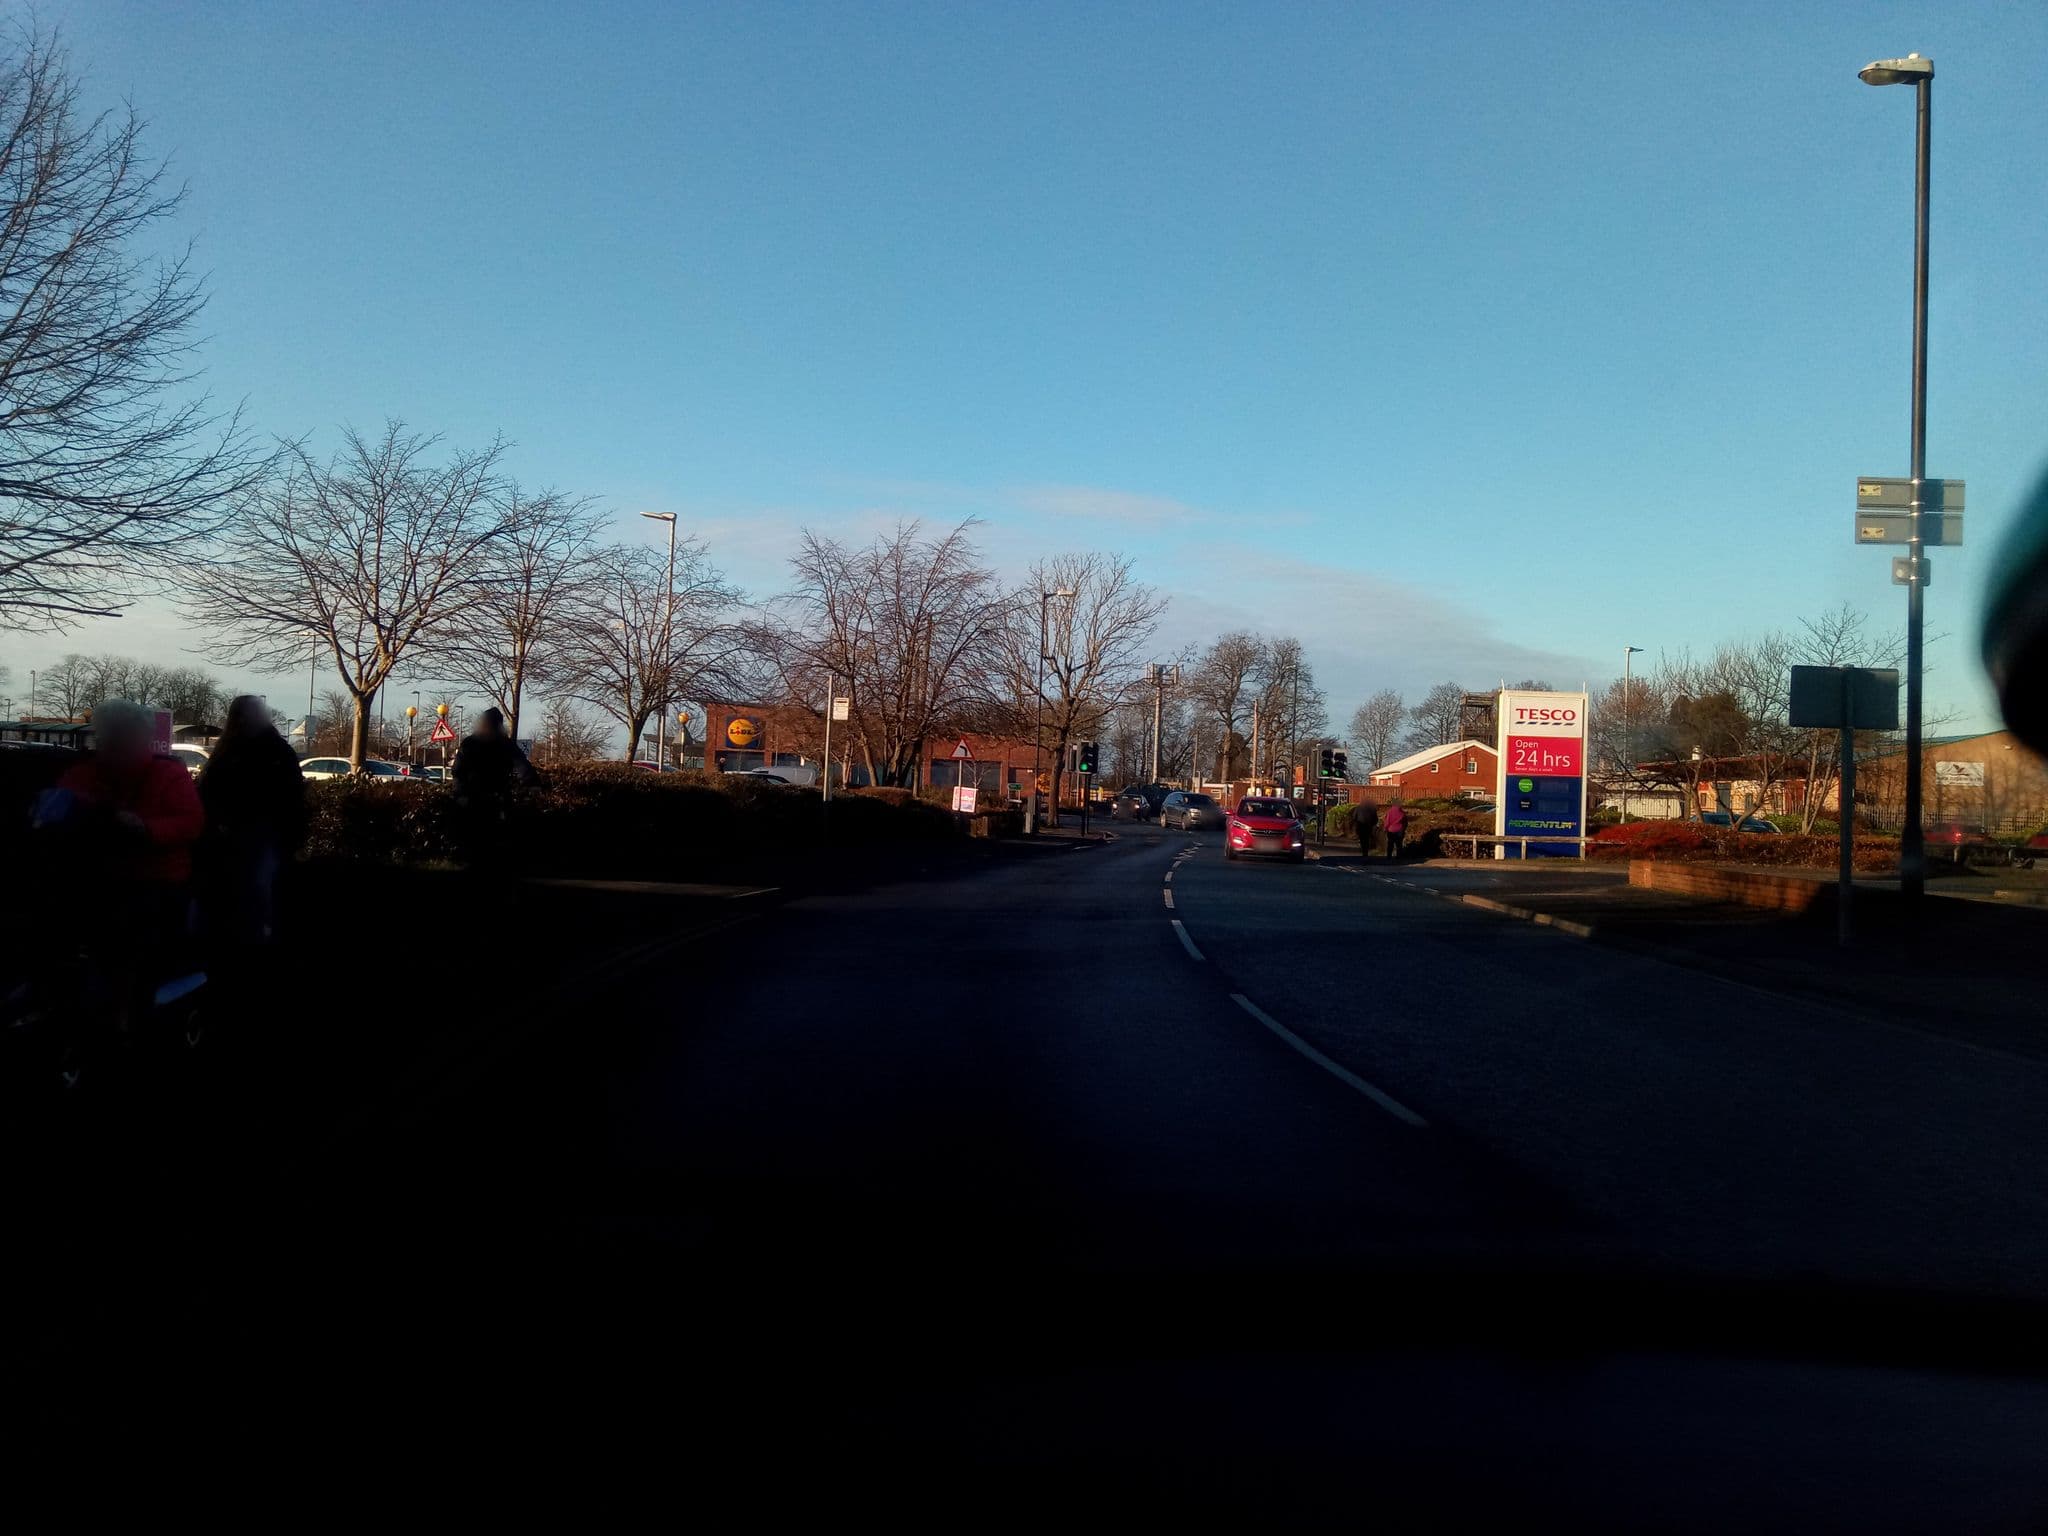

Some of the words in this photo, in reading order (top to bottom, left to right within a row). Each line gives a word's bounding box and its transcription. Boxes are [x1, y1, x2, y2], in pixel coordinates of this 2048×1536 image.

[1515, 708, 1576, 721] TESCO
[1515, 739, 1539, 749] Open
[1515, 749, 1538, 766] 24
[1543, 750, 1571, 768] hrs
